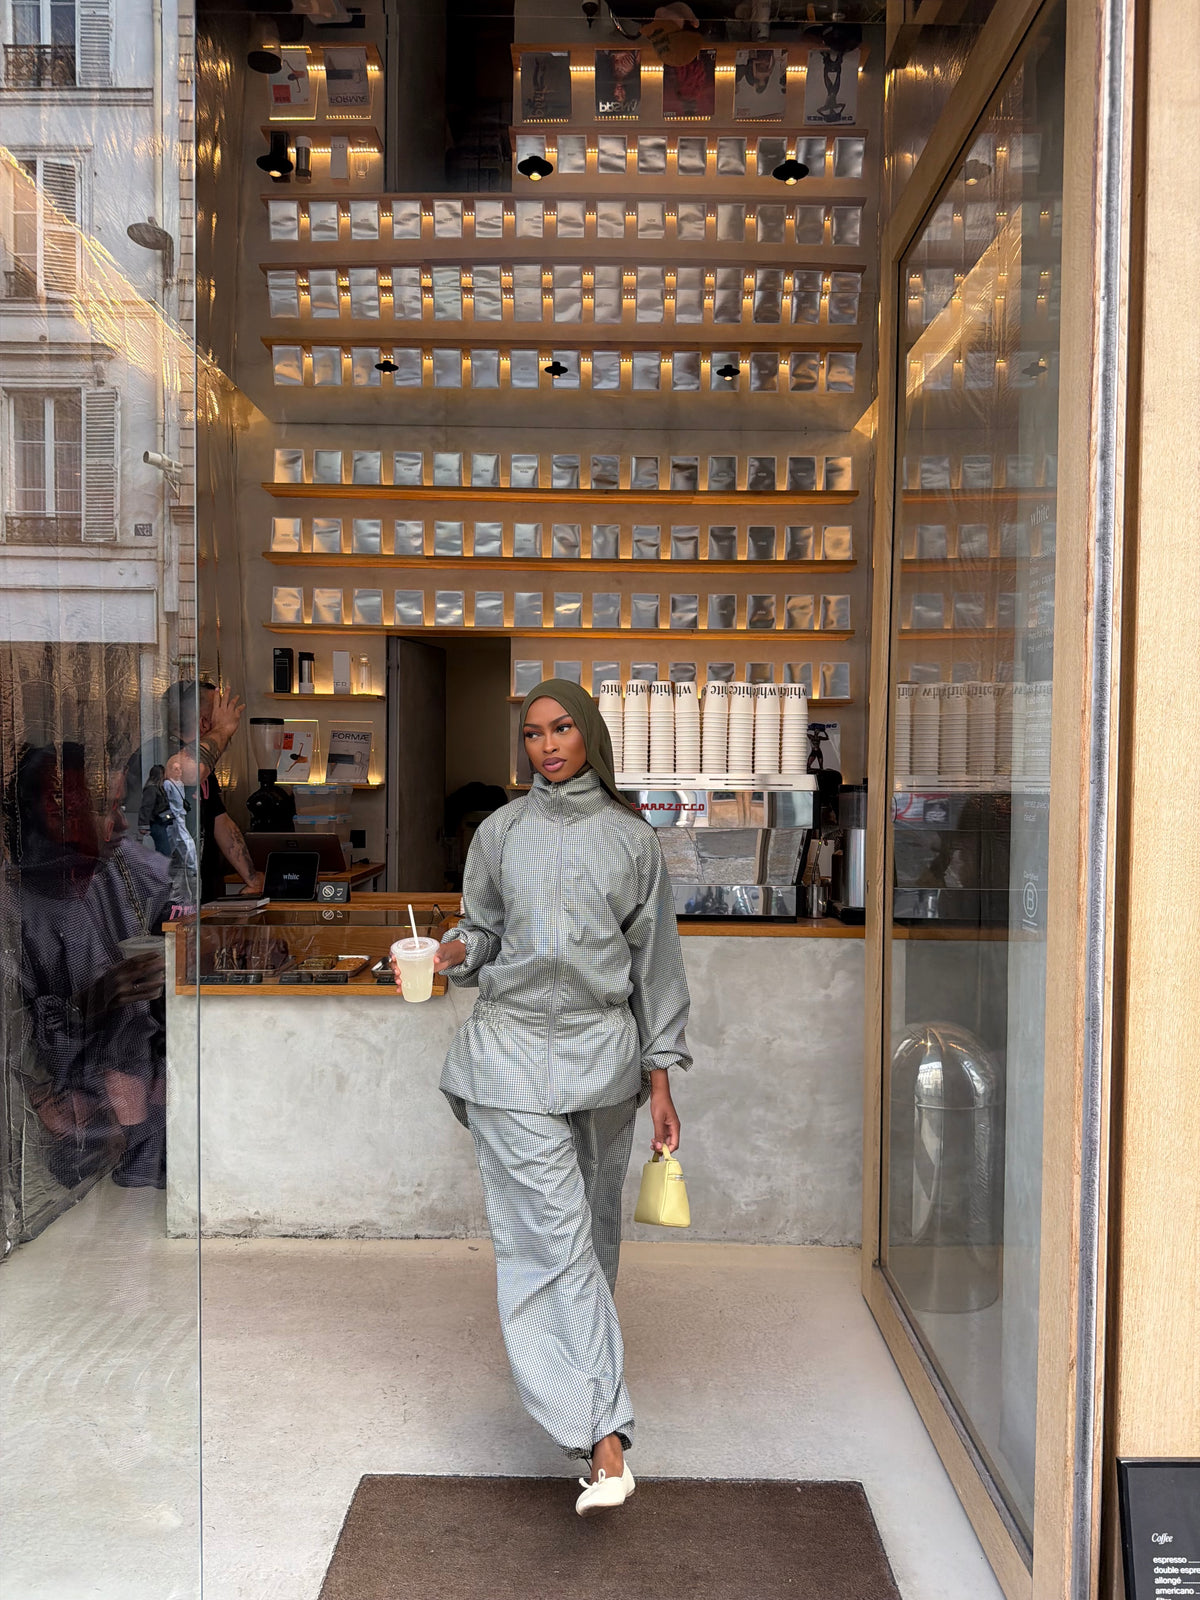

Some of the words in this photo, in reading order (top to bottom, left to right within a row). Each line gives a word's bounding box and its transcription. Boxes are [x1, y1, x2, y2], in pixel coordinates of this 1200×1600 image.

[601, 684, 622, 697] hite
[651, 684, 671, 697] hite
[732, 685, 752, 699] hite
[641, 803, 705, 811] MARZOCCO
[282, 872, 300, 881] white
[1151, 1532, 1173, 1544] Coffee
[1154, 1576, 1182, 1585] allongé
[1155, 1587, 1194, 1595] americano
